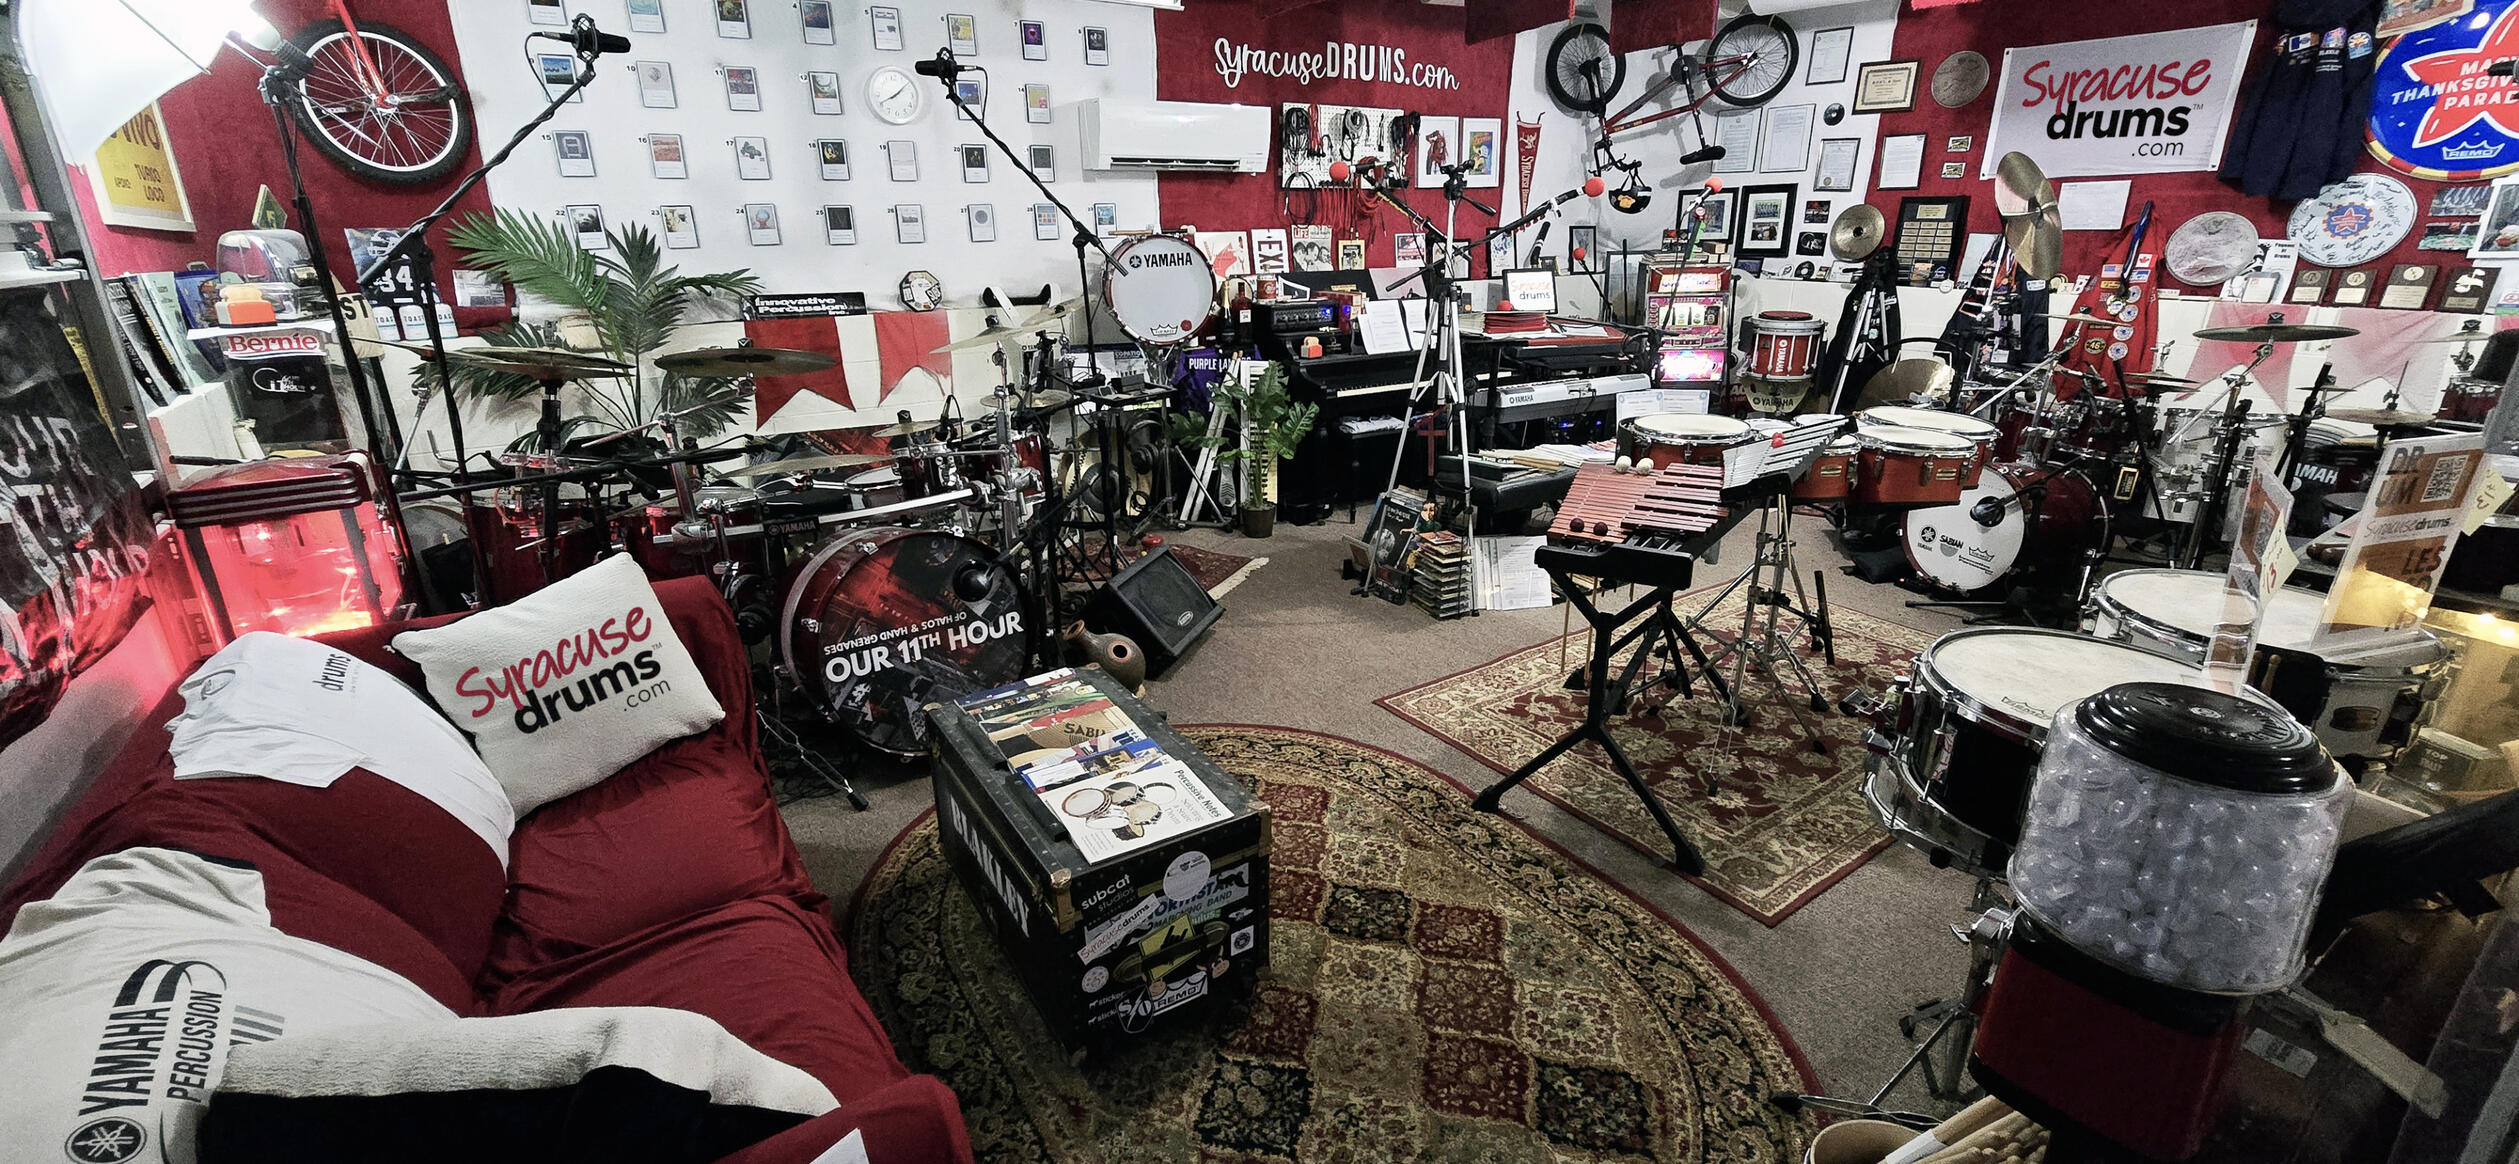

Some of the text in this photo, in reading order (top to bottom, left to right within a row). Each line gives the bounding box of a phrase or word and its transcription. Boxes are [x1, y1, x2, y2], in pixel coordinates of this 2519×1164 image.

[1214, 37, 1460, 91] SyracuseDRUMS.com
[2022, 58, 2211, 116] Syracuse
[2046, 101, 2192, 140] drums
[2132, 142, 2184, 157] .com
[2448, 149, 2495, 158] REMO
[1294, 228, 1309, 238] LIFE
[1144, 252, 1193, 268] YAMAHA
[1257, 240, 1285, 271] EXI
[1519, 290, 1550, 300] drums
[758, 303, 844, 314] Percussion
[228, 333, 318, 352] Bernie
[1188, 358, 1218, 370] PURPLE
[1774, 348, 1787, 372] YAMAHA
[1515, 395, 1534, 404] YAMAHA
[780, 520, 816, 534] YAMAHA
[1940, 534, 1964, 549] SABIAN
[824, 612, 967, 656] OF HALOS & HAND GRENADES
[825, 612, 1024, 684] OUR 11TH HOUR
[312, 654, 351, 692] drums
[456, 607, 652, 718] Syracuse
[514, 650, 661, 734] drums
[624, 680, 672, 712] .com
[1174, 769, 1222, 818] Percussive Notes
[1081, 874, 1130, 910] subcat
[1098, 887, 1134, 912] studios
[1207, 890, 1232, 906] BAND
[1157, 986, 1200, 1009] REMO
[166, 990, 222, 1103] PERCUSSION
[78, 1006, 171, 1116] YAMAHA
